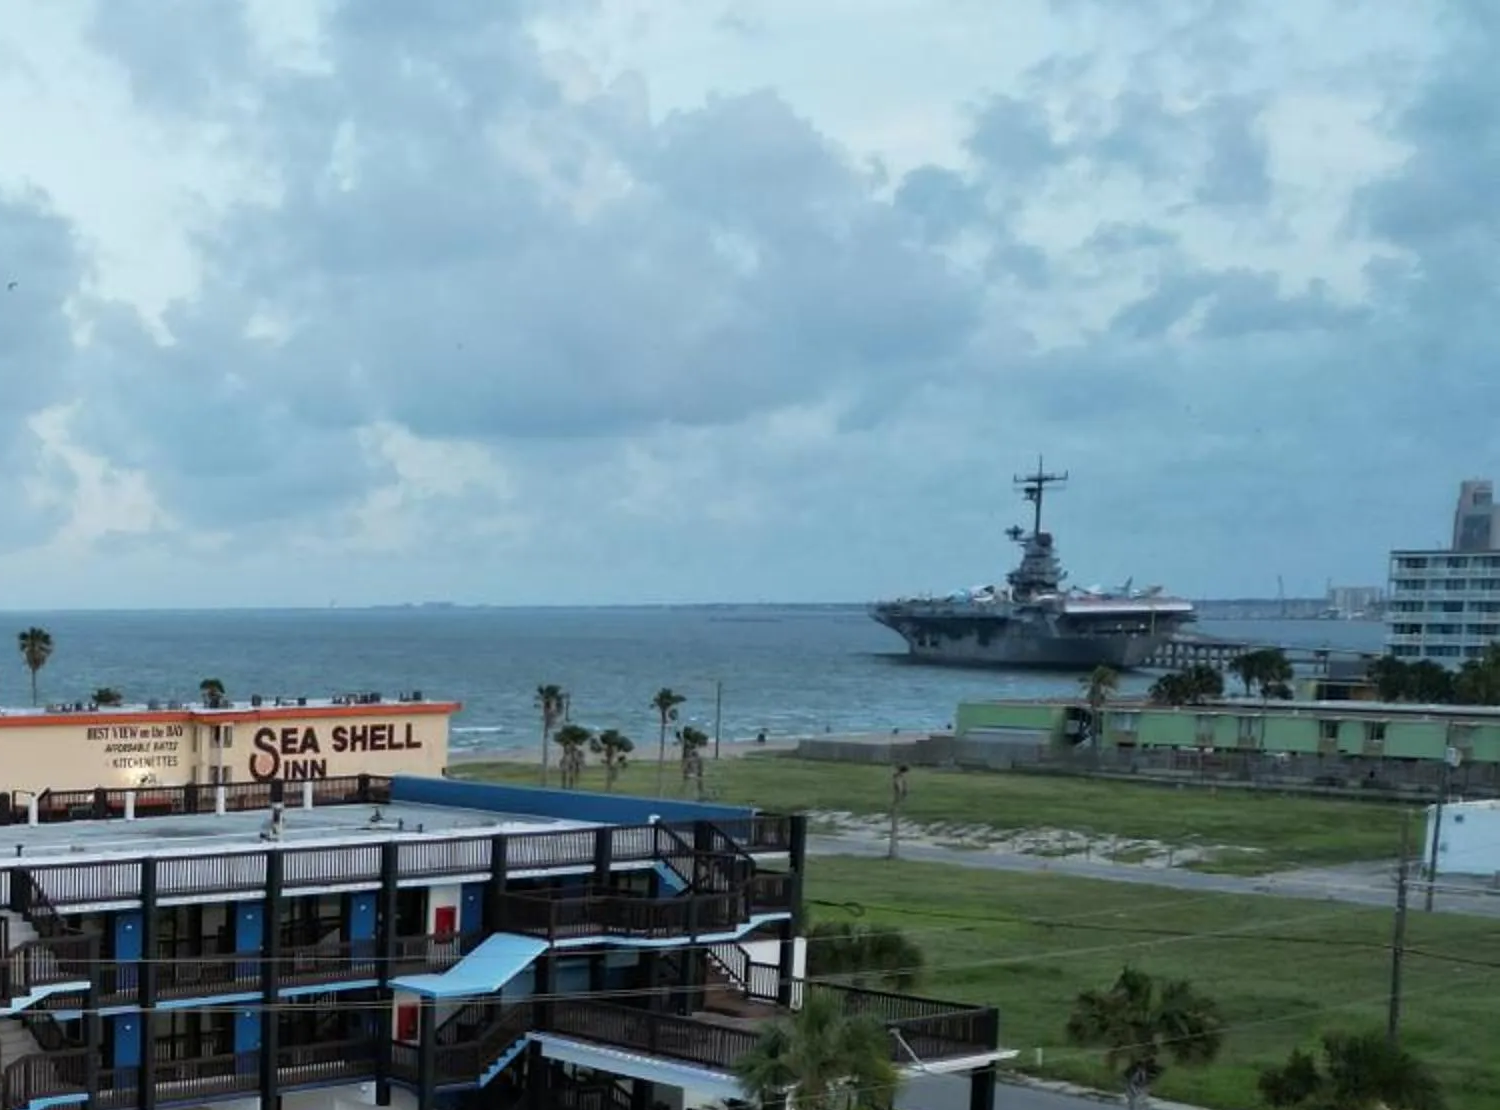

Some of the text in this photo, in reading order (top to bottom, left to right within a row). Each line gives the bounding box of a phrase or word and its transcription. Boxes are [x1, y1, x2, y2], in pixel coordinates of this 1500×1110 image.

[86, 727, 109, 740] BEST
[111, 726, 139, 739] VIEW
[249, 722, 422, 782] SEA SHELL
[283, 759, 327, 780] INN
